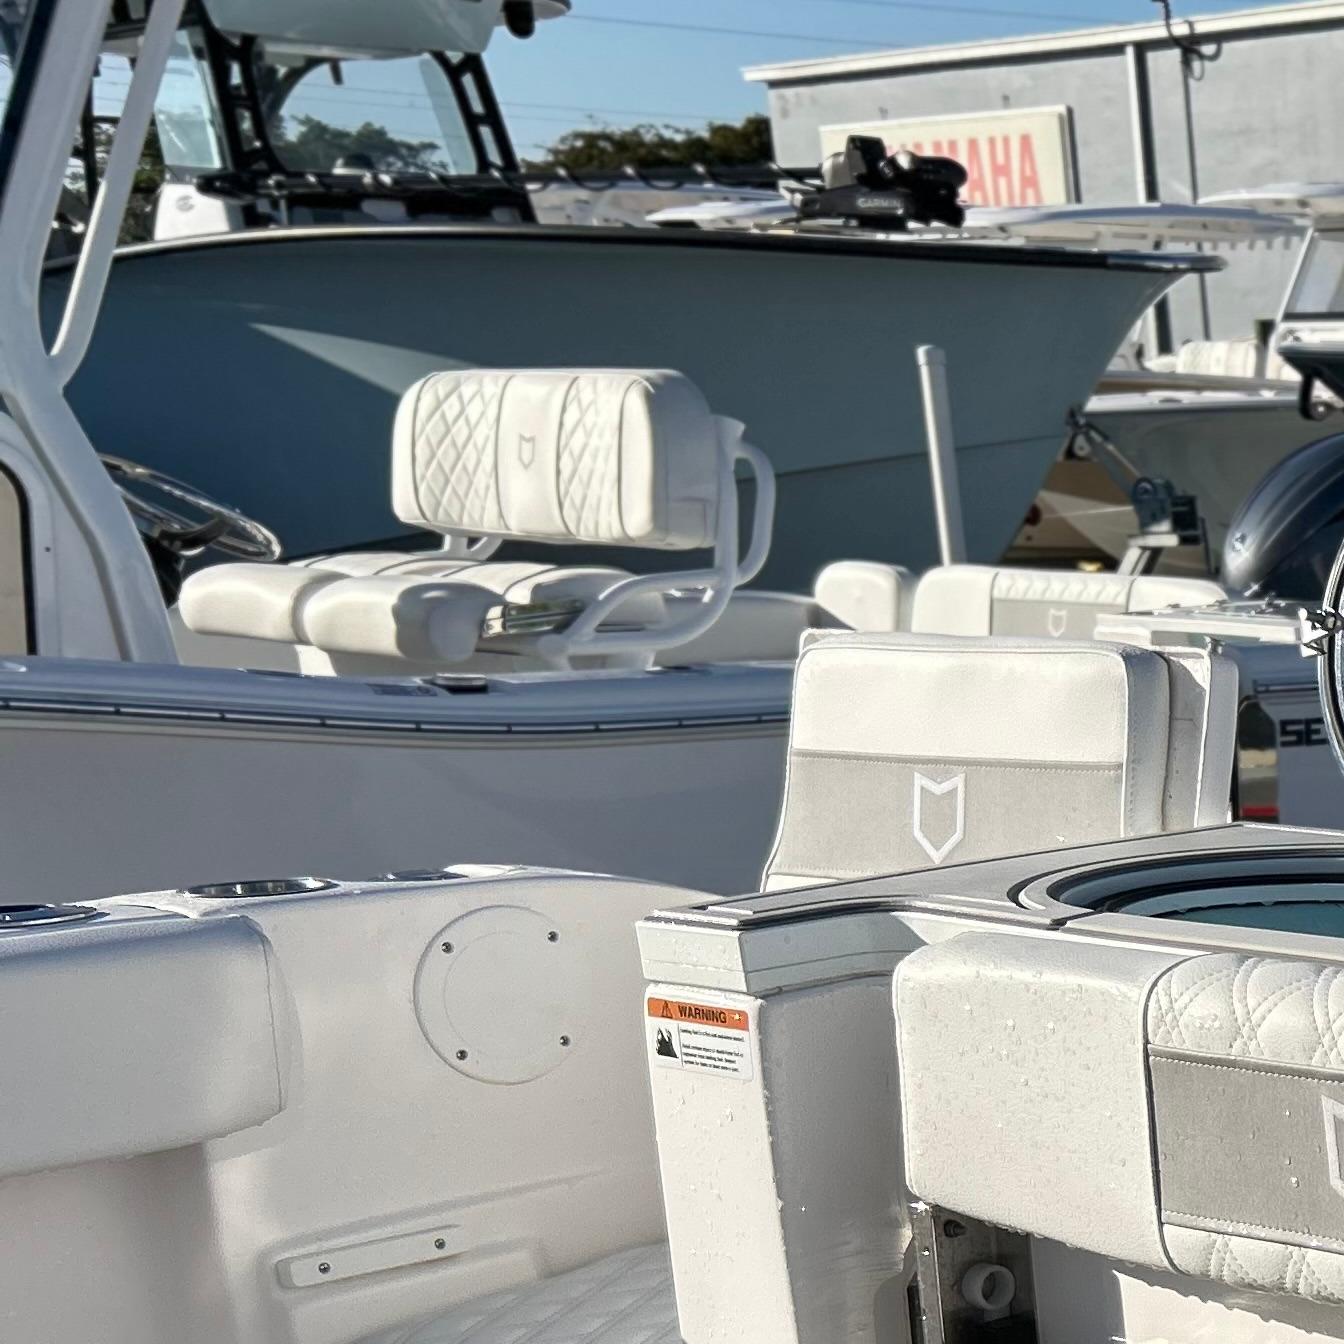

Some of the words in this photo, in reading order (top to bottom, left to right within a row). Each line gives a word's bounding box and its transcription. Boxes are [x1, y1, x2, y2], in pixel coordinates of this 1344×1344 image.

[887, 133, 1044, 207] AHA
[857, 197, 904, 208] GARMIN
[679, 1006, 727, 1023] WARNING
